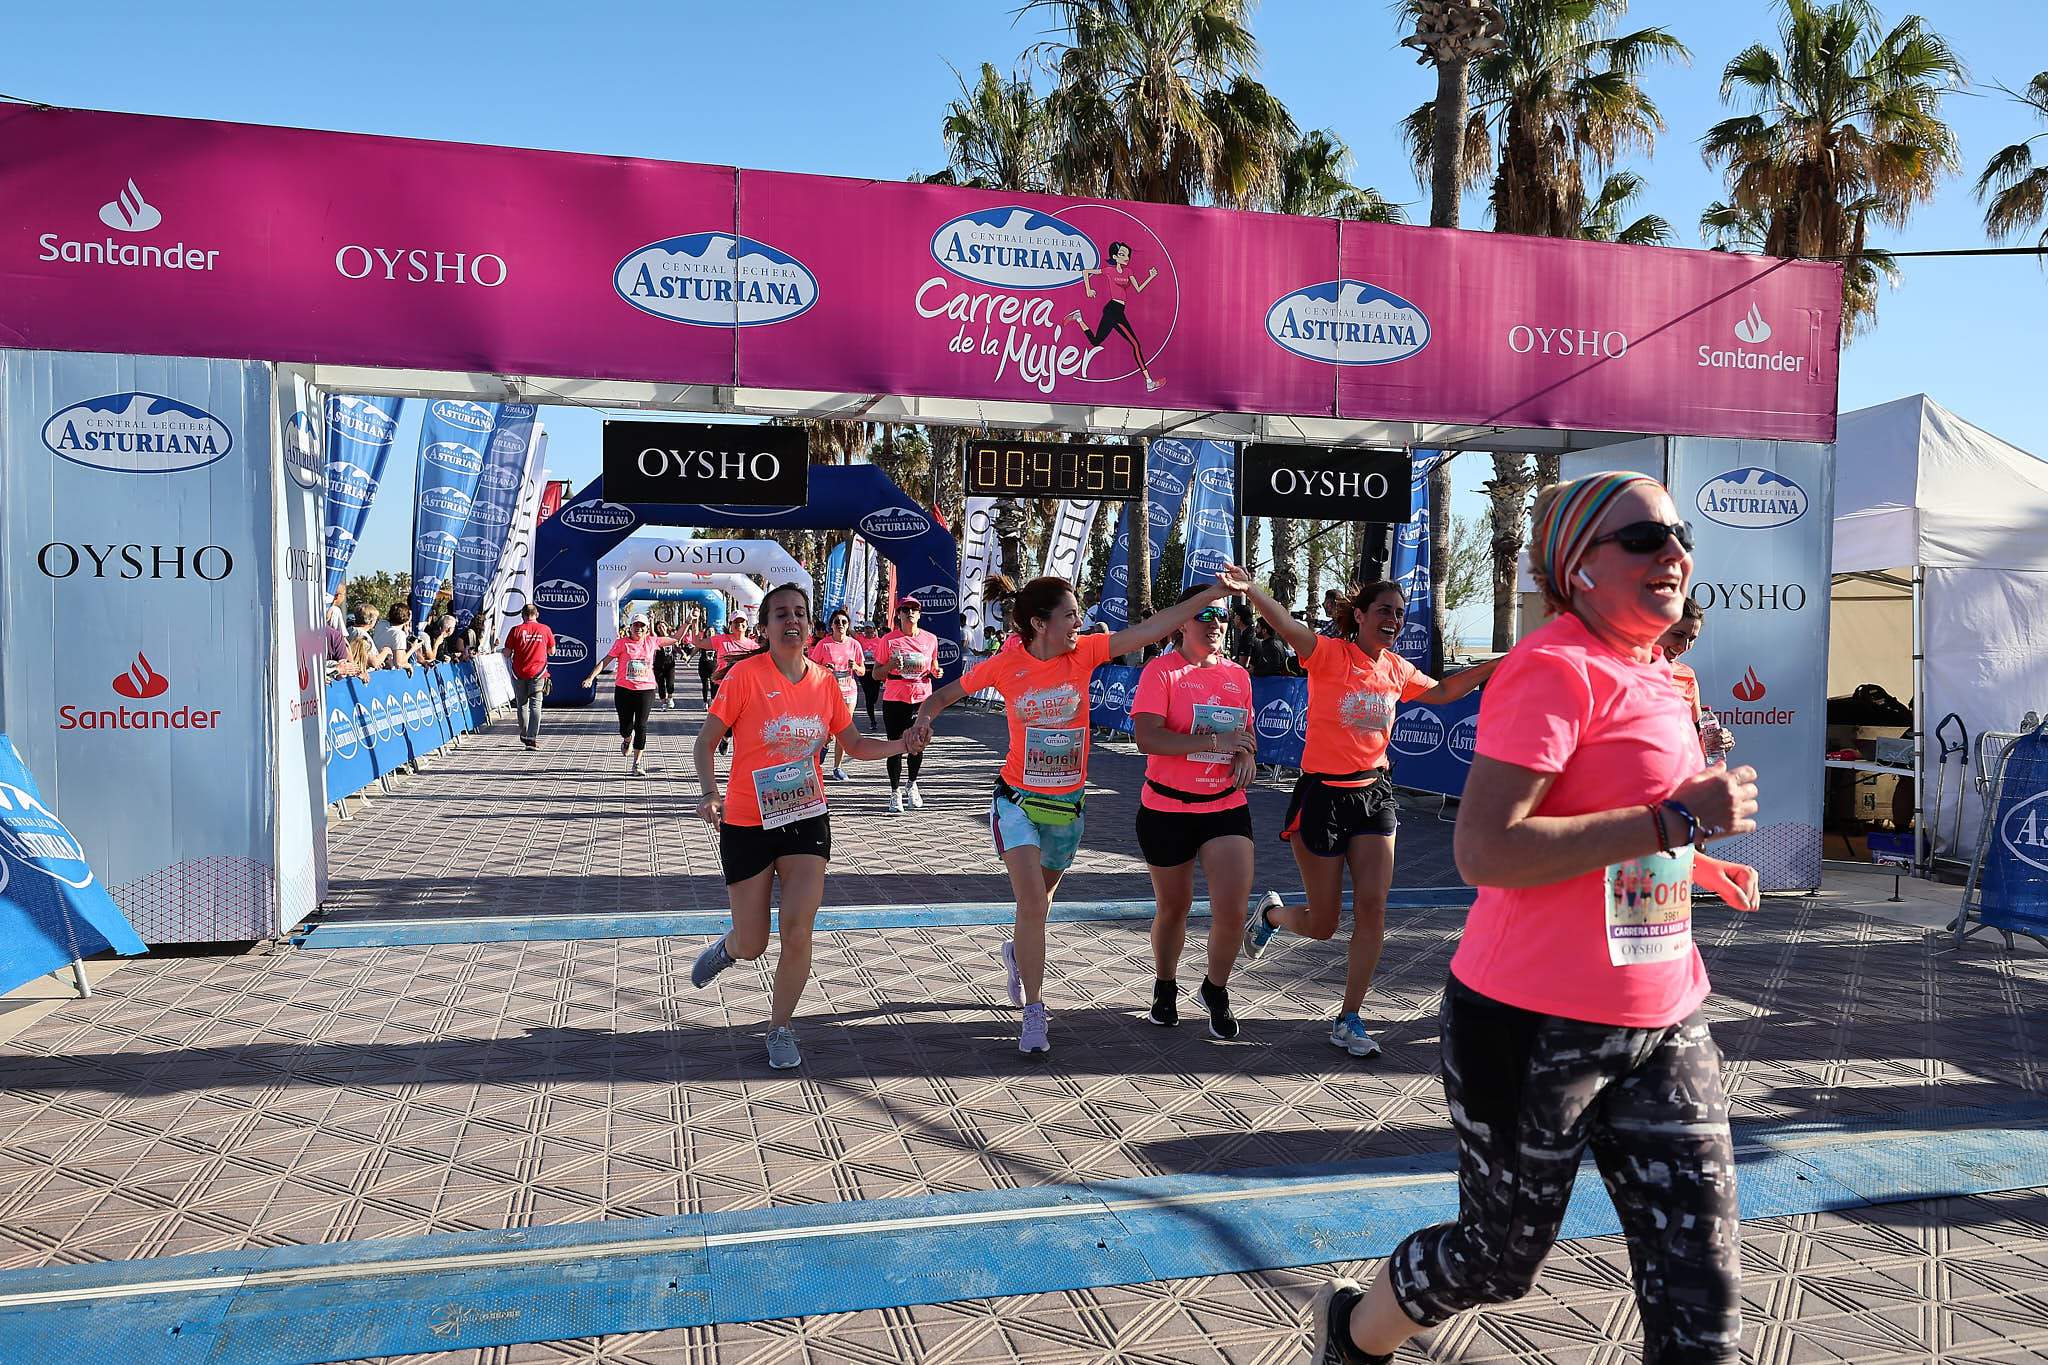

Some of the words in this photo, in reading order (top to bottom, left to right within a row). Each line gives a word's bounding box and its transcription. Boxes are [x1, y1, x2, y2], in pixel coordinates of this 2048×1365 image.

[39, 233, 219, 270] Santander
[944, 231, 1086, 272] ASTURIANA
[971, 232, 1024, 244] CENTRAL
[1029, 236, 1082, 248] LECHERA
[336, 245, 507, 286] OYSHO
[662, 262, 726, 274] CENTRAL
[732, 267, 797, 278] LECHERA
[630, 262, 803, 306] ASTURIANA
[914, 277, 1054, 328] Carrera
[1304, 306, 1357, 318] CENTRAL
[1360, 310, 1413, 321] LECHERA
[1279, 307, 1418, 346] ASTURIANA
[1508, 325, 1628, 359] OYSHO
[949, 324, 974, 354] de
[981, 324, 1000, 356] la
[994, 324, 1104, 394] Mujer
[1698, 345, 1805, 372] Santander
[87, 418, 147, 430] CENTRAL
[153, 421, 212, 431] LECHERA
[57, 420, 219, 455] ASTURIANA
[638, 447, 780, 481] OYSHO
[978, 450, 1131, 490] 00:41:59
[1149, 477, 1181, 493] STURIANA
[1271, 468, 1389, 499] OYSHO
[1760, 489, 1797, 497] LECHERA
[1704, 489, 1800, 515] ASTURIANA
[565, 510, 629, 525] ASTURIANA
[866, 520, 926, 531] ASTURIANA
[37, 542, 234, 581] OYSHO
[286, 546, 321, 583] OYSHO
[654, 545, 746, 564] OYSHO
[598, 564, 627, 572] OYSHO
[535, 589, 585, 603] ASTURIANA
[1690, 582, 1806, 611] OYSHO
[59, 705, 221, 730] Santander
[1715, 707, 1795, 725] antander
[1391, 725, 1439, 745] ASTURIANA
[1654, 880, 1688, 905] 016
[1615, 925, 1649, 937] CARRERA
[1650, 926, 1660, 936] DE
[1660, 924, 1669, 935] LA
[1622, 943, 1663, 956] OYSHO
